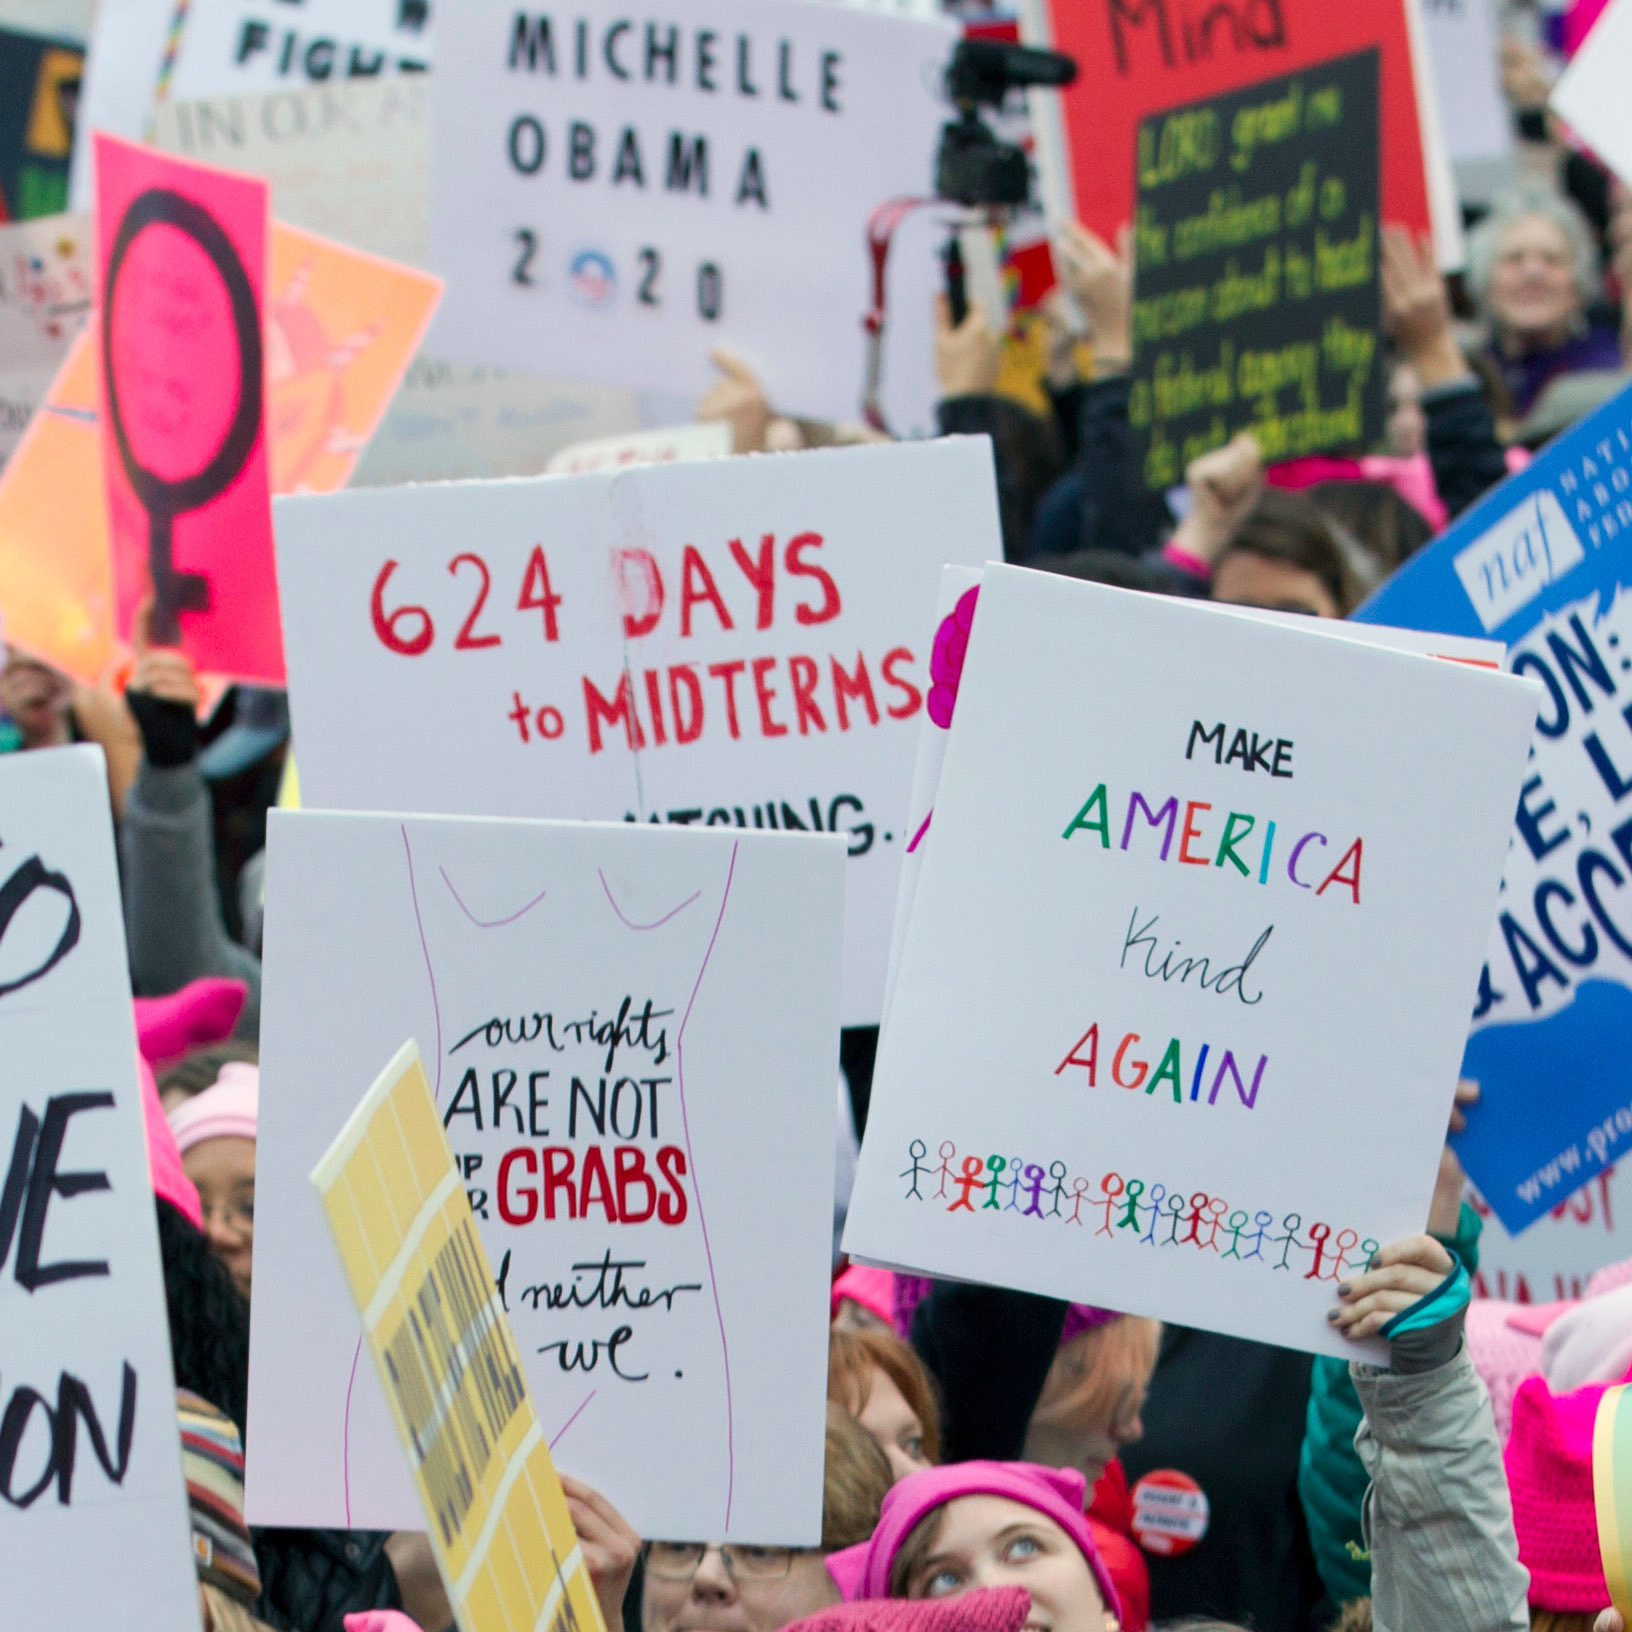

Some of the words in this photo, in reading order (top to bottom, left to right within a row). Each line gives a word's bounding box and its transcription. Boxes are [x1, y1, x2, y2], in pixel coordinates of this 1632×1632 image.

[236, 18, 428, 82] FIGH
[509, 12, 847, 113] MICHELLE
[506, 114, 769, 209] OBAMA
[1477, 491, 1558, 604] naf
[370, 544, 562, 656] 624
[611, 531, 842, 639] DAYS
[508, 690, 564, 744] to
[582, 647, 923, 755] MIDTERMS
[1185, 720, 1294, 778] MAKE
[1061, 783, 1365, 904] AMERICA
[448, 1012, 565, 1055] our
[565, 995, 675, 1073] rights
[1055, 1022, 1268, 1110] AGAIN
[442, 1066, 551, 1138] ARE
[568, 1075, 673, 1140] NOT
[496, 1145, 688, 1227] GRABS
[521, 1247, 703, 1312] neither
